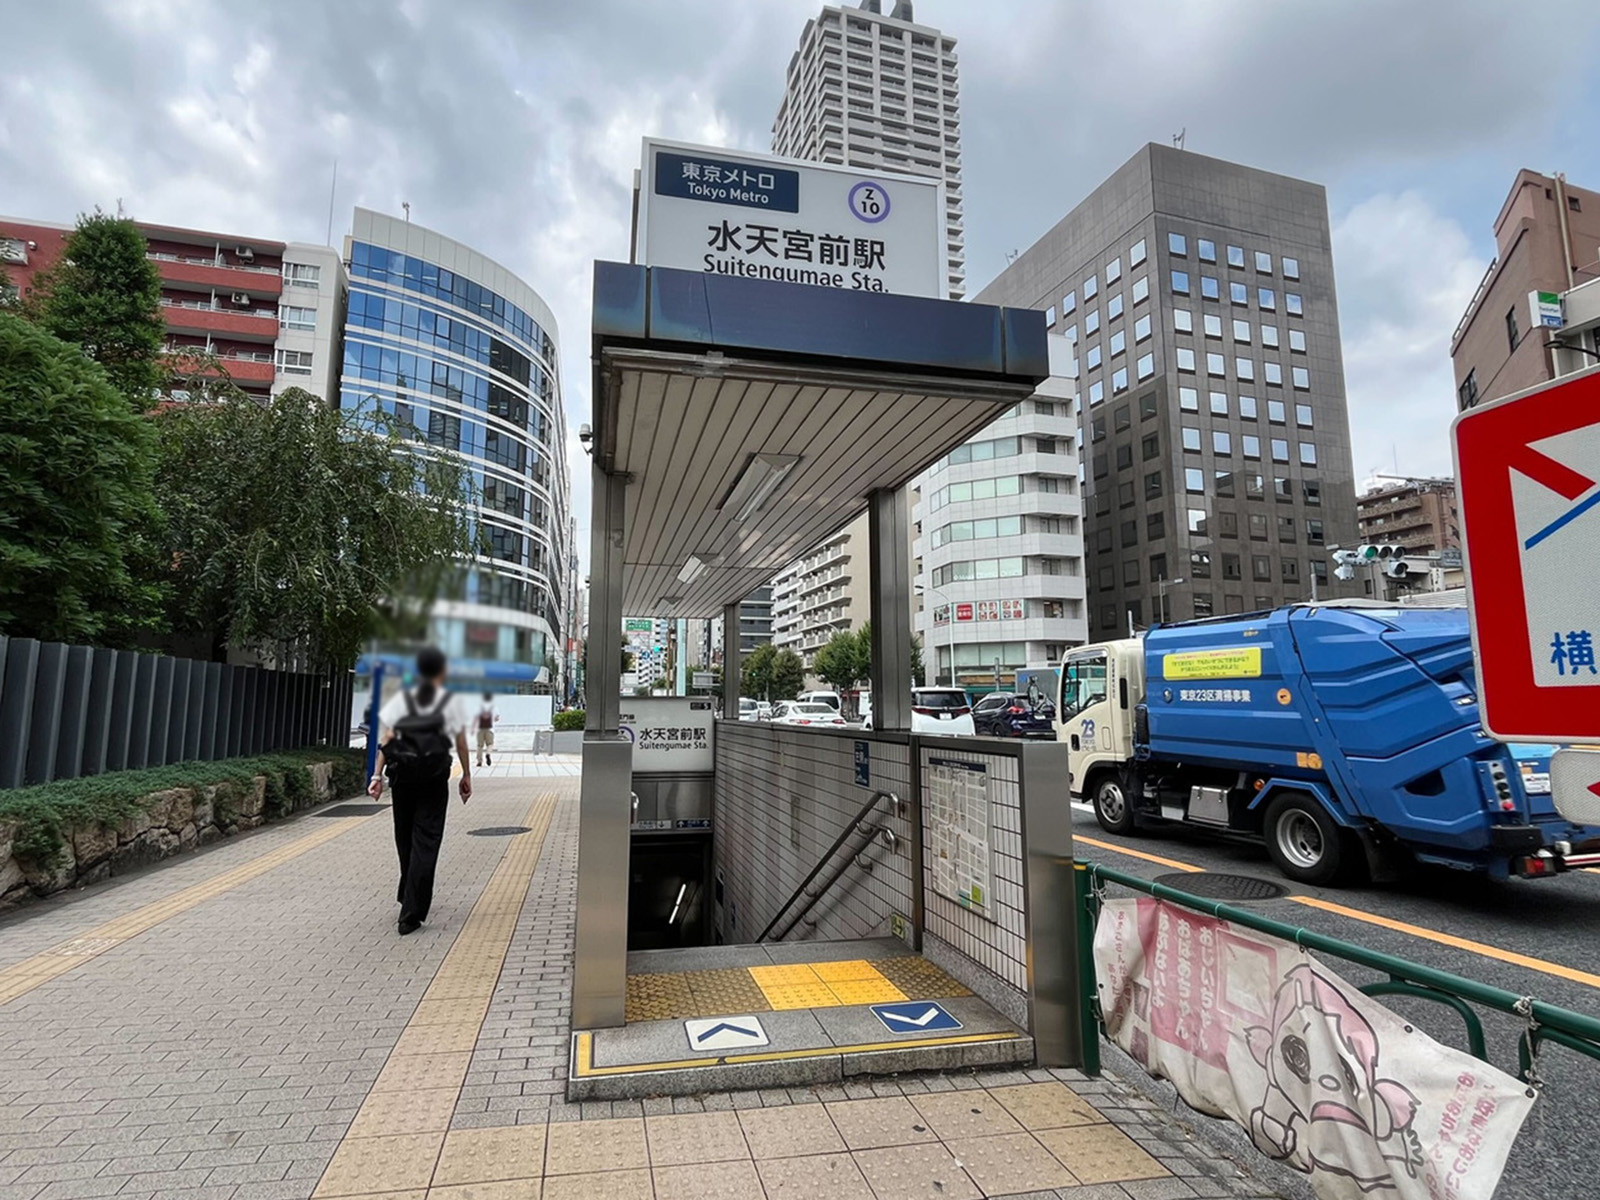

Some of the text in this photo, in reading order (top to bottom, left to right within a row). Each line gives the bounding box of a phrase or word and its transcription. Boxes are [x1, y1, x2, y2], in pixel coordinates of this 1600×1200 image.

[682, 162, 774, 190] 東京メトロ
[687, 182, 769, 203] Tokyo Metro
[864, 189, 875, 199] Z
[861, 201, 880, 215] 10
[707, 220, 886, 271] 水天宮前駅
[704, 254, 889, 293] Suitengumae Sta.
[1550, 629, 1597, 675] 横
[1180, 689, 1251, 702] 東京23区清掃事業
[640, 728, 706, 741] 水天宮前駅
[639, 741, 691, 751] Suitengumae
